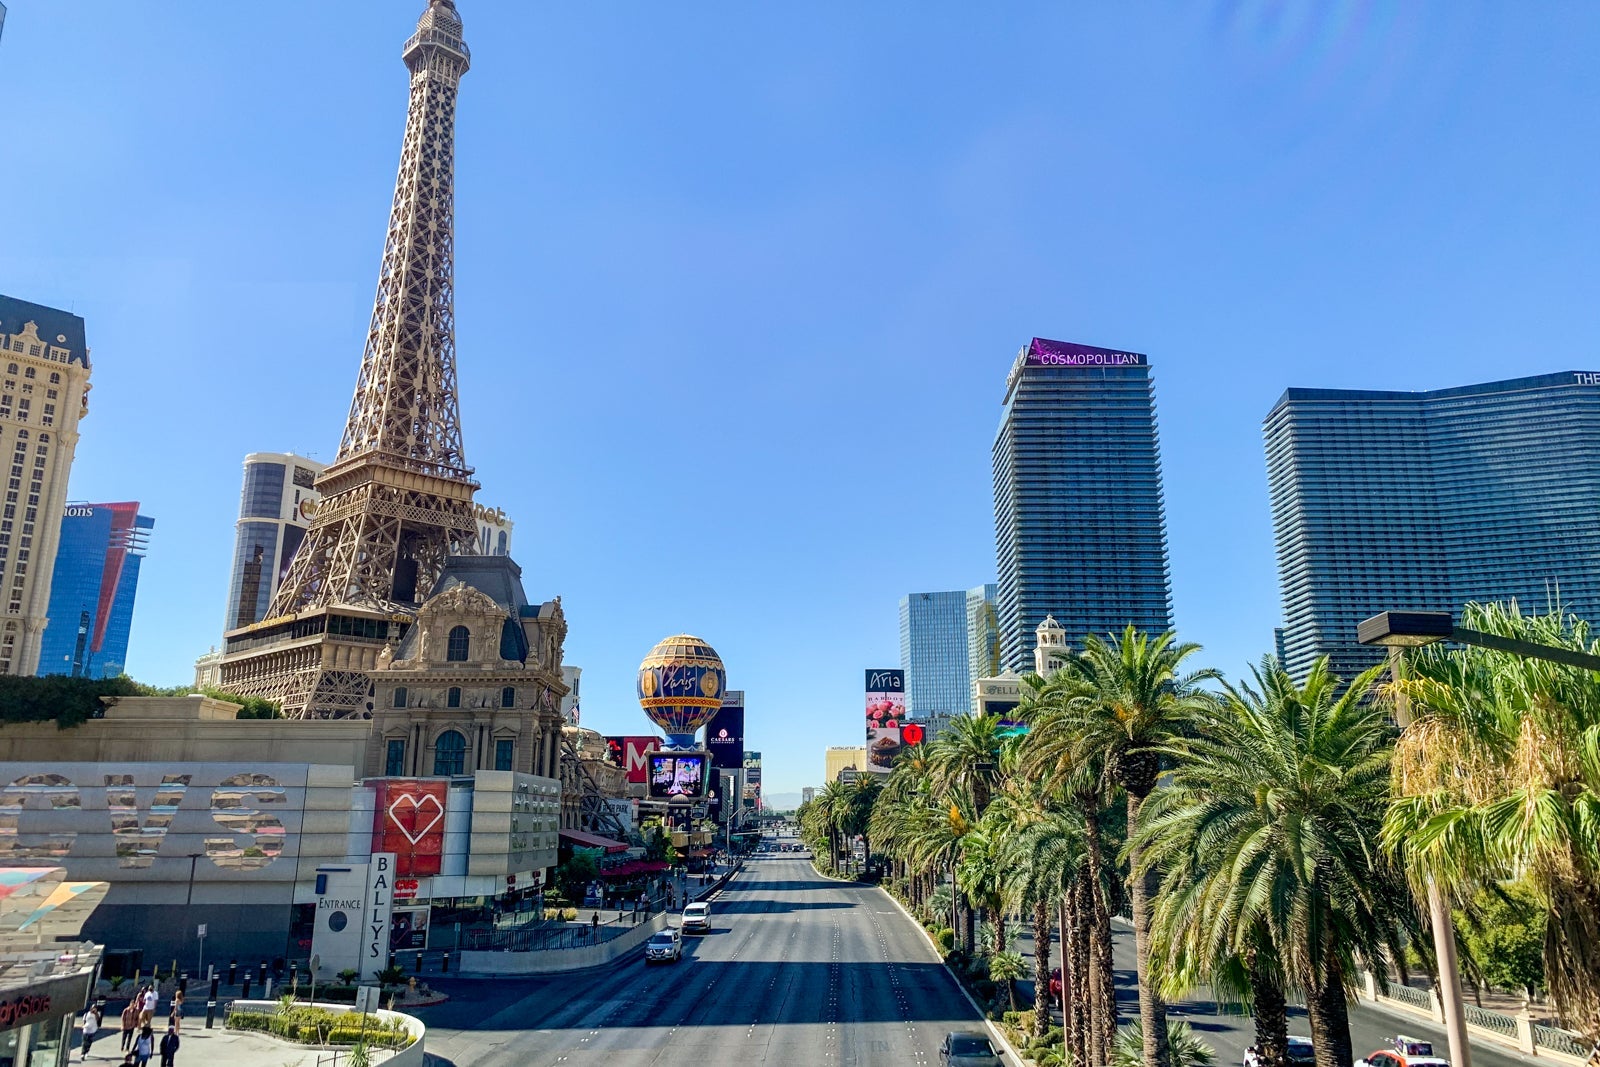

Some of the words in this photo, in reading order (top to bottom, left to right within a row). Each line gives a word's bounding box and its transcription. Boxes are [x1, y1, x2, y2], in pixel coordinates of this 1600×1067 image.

[1041, 353, 1139, 366] COSMOPOLITAN
[1573, 372, 1600, 385] THE
[662, 661, 696, 690] Paris
[869, 671, 901, 689] Aria
[743, 758, 761, 769] GM
[0, 773, 287, 872] CVS
[394, 879, 419, 890] CVS
[319, 898, 361, 909] ENTRANCE
[370, 857, 388, 958] BALLYS
